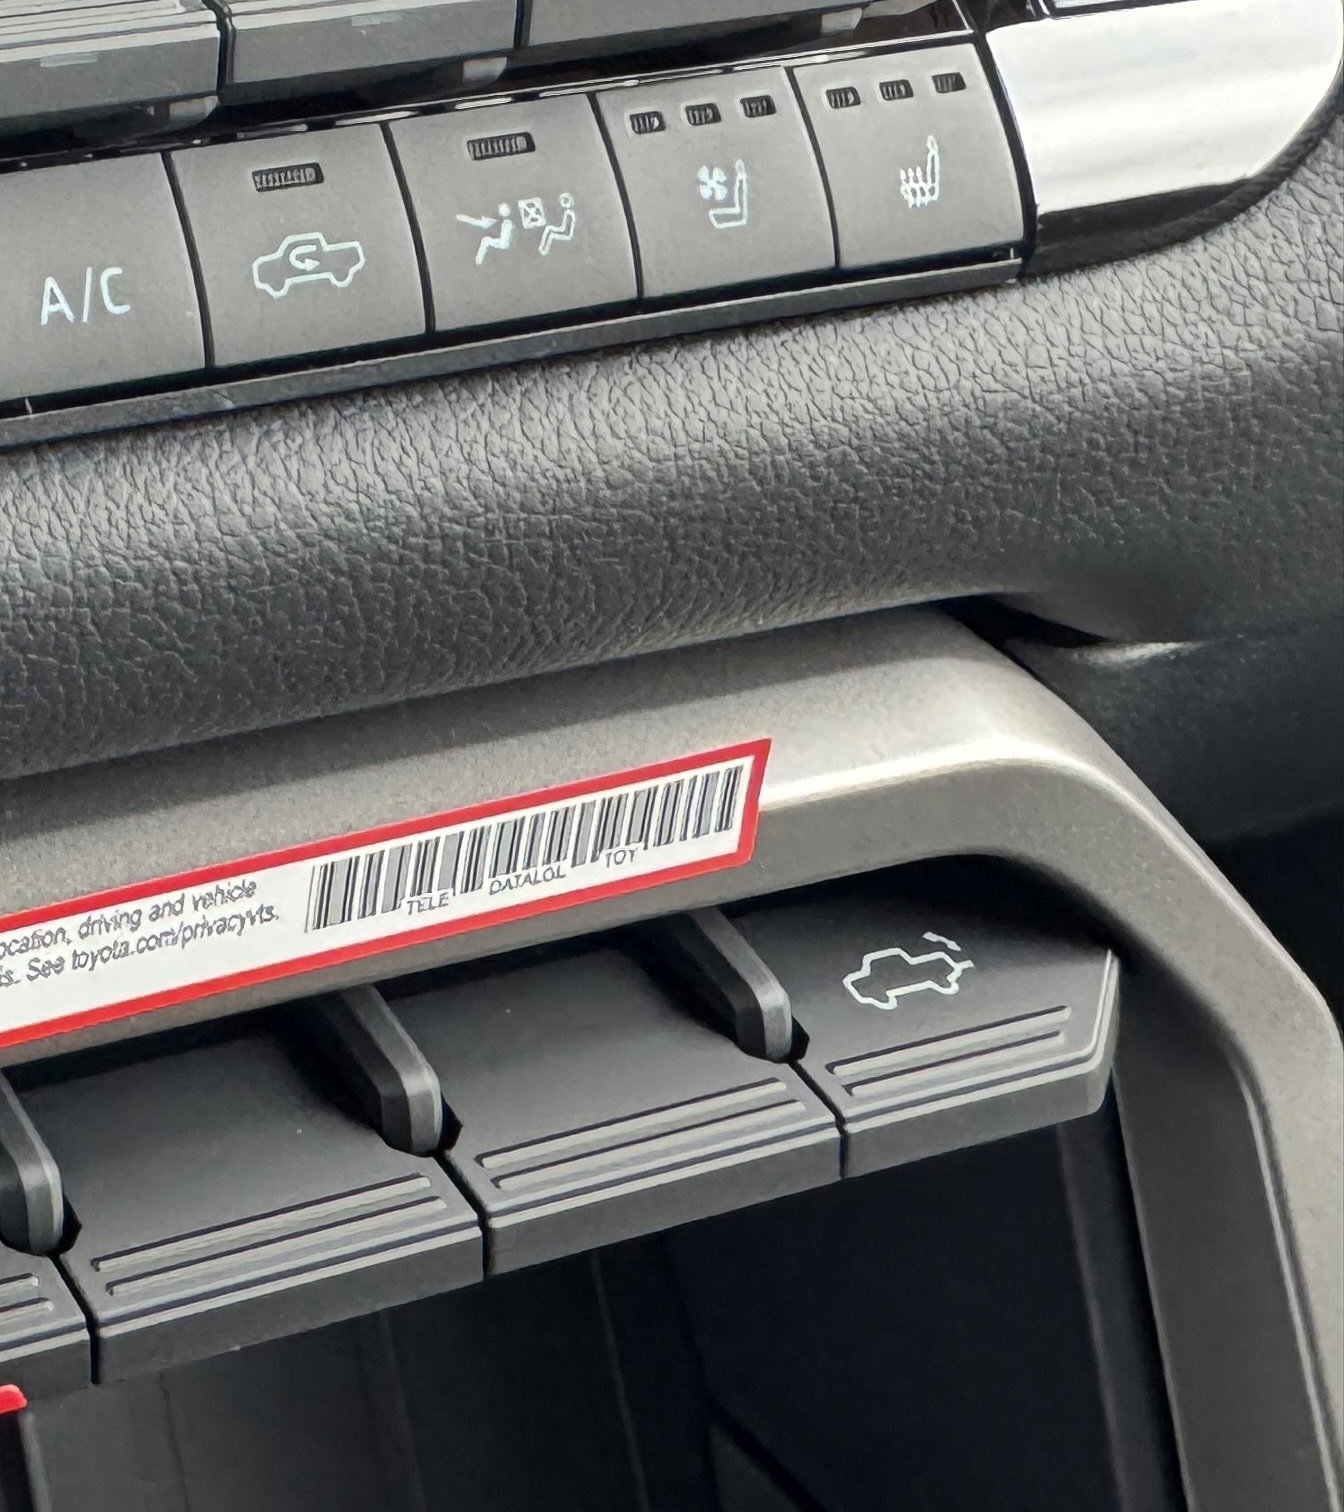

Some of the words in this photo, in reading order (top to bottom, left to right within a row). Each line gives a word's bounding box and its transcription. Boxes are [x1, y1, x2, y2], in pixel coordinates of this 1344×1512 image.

[39, 266, 131, 326] A/C
[78, 908, 142, 939] driving
[149, 893, 185, 921] and
[192, 878, 258, 913] vehicle
[27, 956, 66, 982] See
